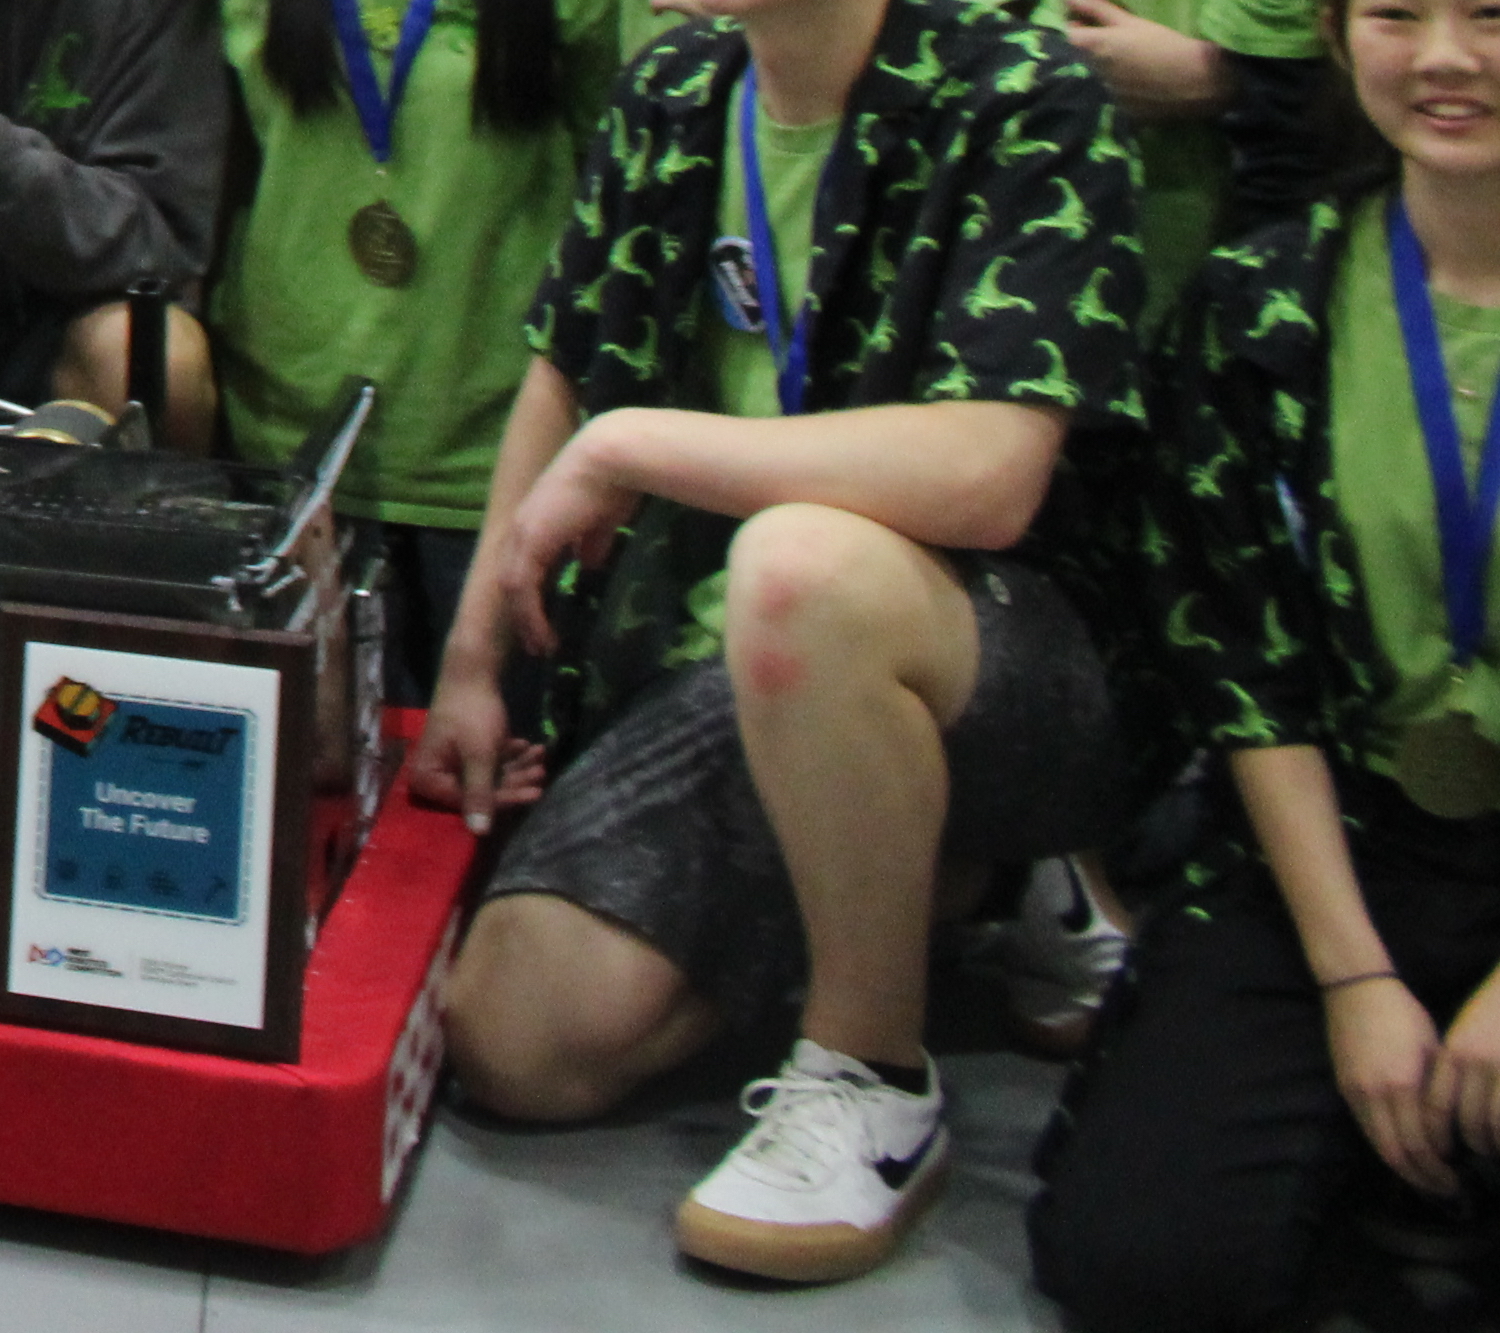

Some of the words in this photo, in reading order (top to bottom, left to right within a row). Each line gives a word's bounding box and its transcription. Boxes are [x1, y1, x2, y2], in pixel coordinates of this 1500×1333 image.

[94, 780, 196, 814] Uncover
[79, 806, 125, 834] The
[129, 812, 211, 845] Future
